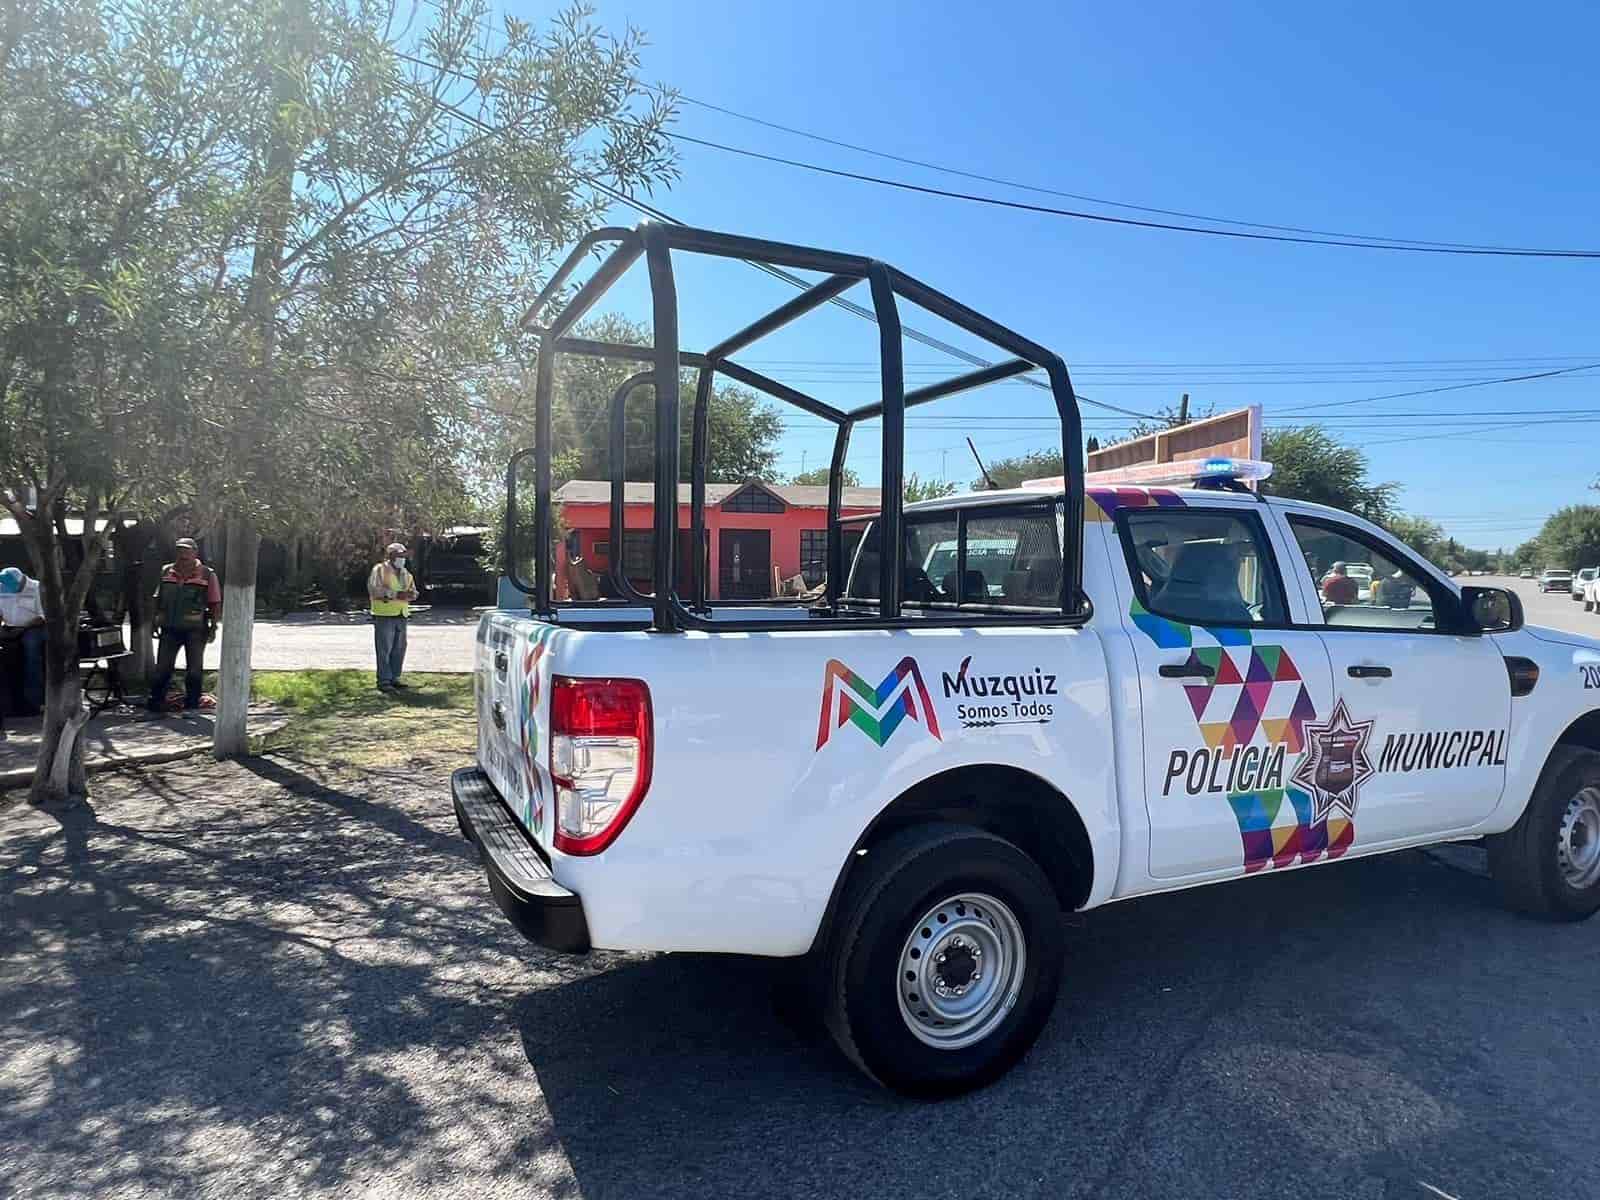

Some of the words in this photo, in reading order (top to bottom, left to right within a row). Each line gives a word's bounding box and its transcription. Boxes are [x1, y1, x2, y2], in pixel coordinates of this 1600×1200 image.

[958, 704, 1008, 719] Somos
[1011, 700, 1053, 717] Todos
[1162, 745, 1285, 796] POLICIA
[1378, 729, 1504, 773] MUNICIPAL
